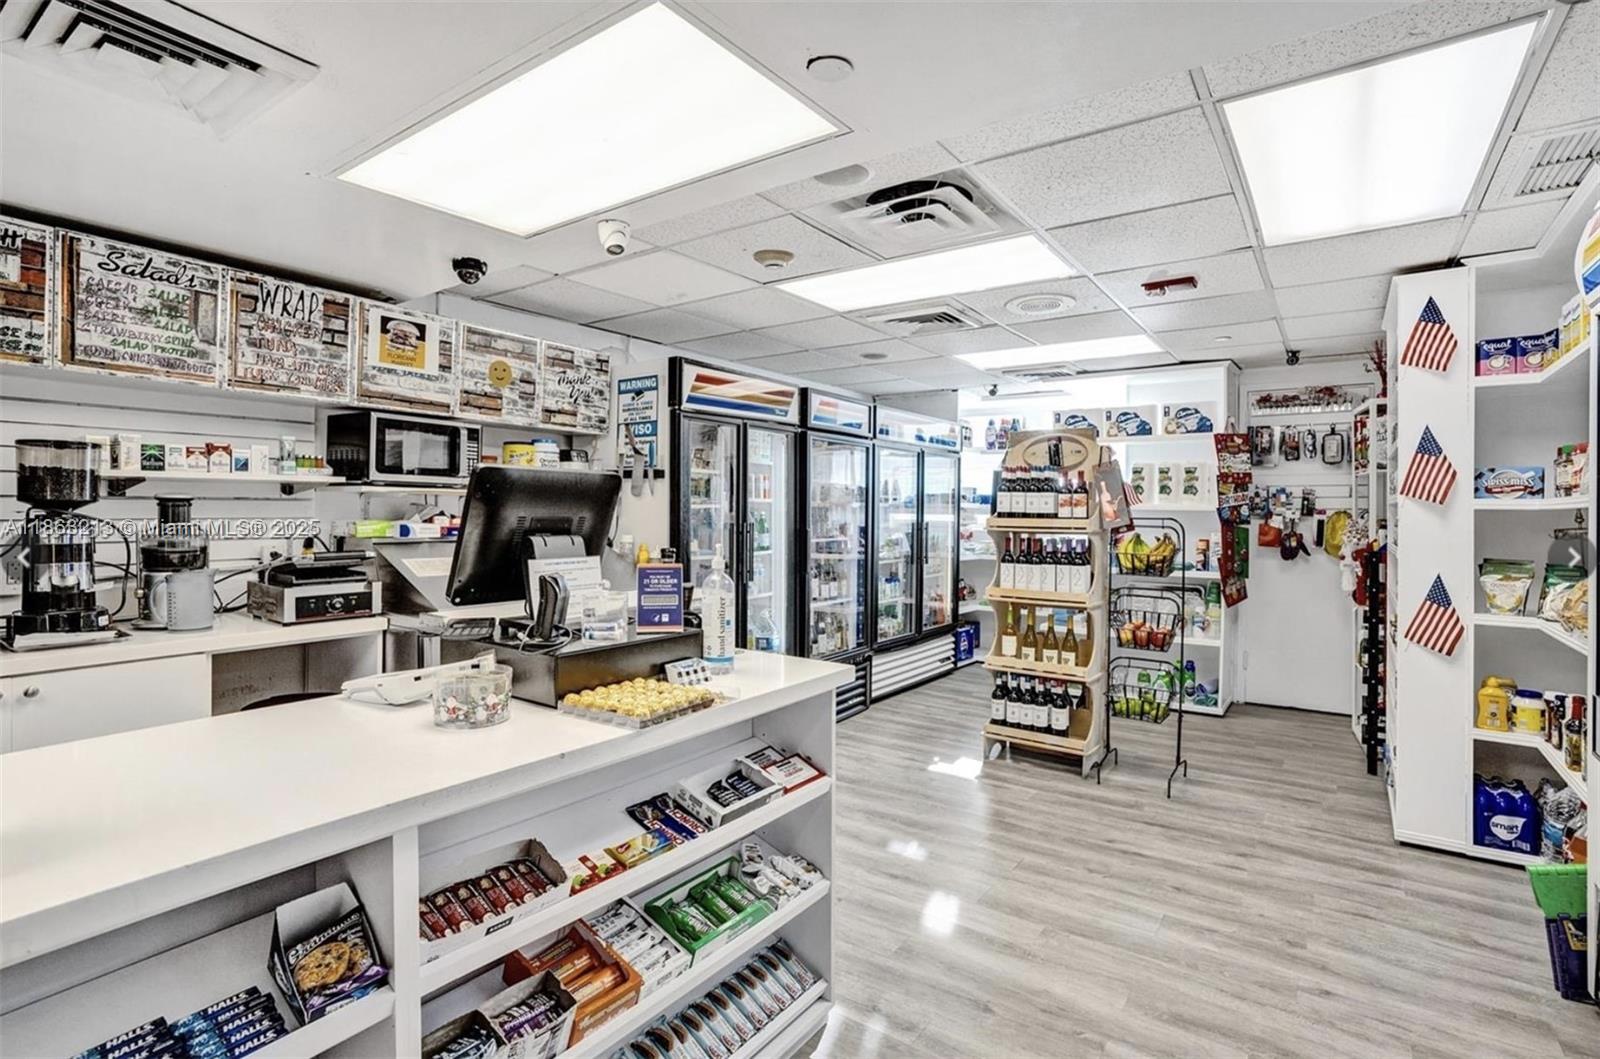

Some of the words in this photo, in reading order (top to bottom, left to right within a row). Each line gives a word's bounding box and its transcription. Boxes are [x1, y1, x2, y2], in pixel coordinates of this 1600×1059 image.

[97, 251, 198, 288] Salads
[148, 288, 190, 305] SALAD
[260, 283, 319, 322] WRAP
[111, 338, 149, 352] SALAD
[556, 370, 592, 386] Thank
[620, 378, 656, 391] WARNING
[717, 597, 726, 634] sanitizer
[717, 635, 726, 657] hand
[206, 991, 249, 1015] HALLS
[217, 1005, 246, 1021] HALLS
[223, 1008, 265, 1033] HALLS
[230, 1018, 273, 1043] HALLS
[106, 1023, 155, 1050] HALLS
[108, 1034, 158, 1059] HALLS
[234, 1029, 278, 1056] HALLS
